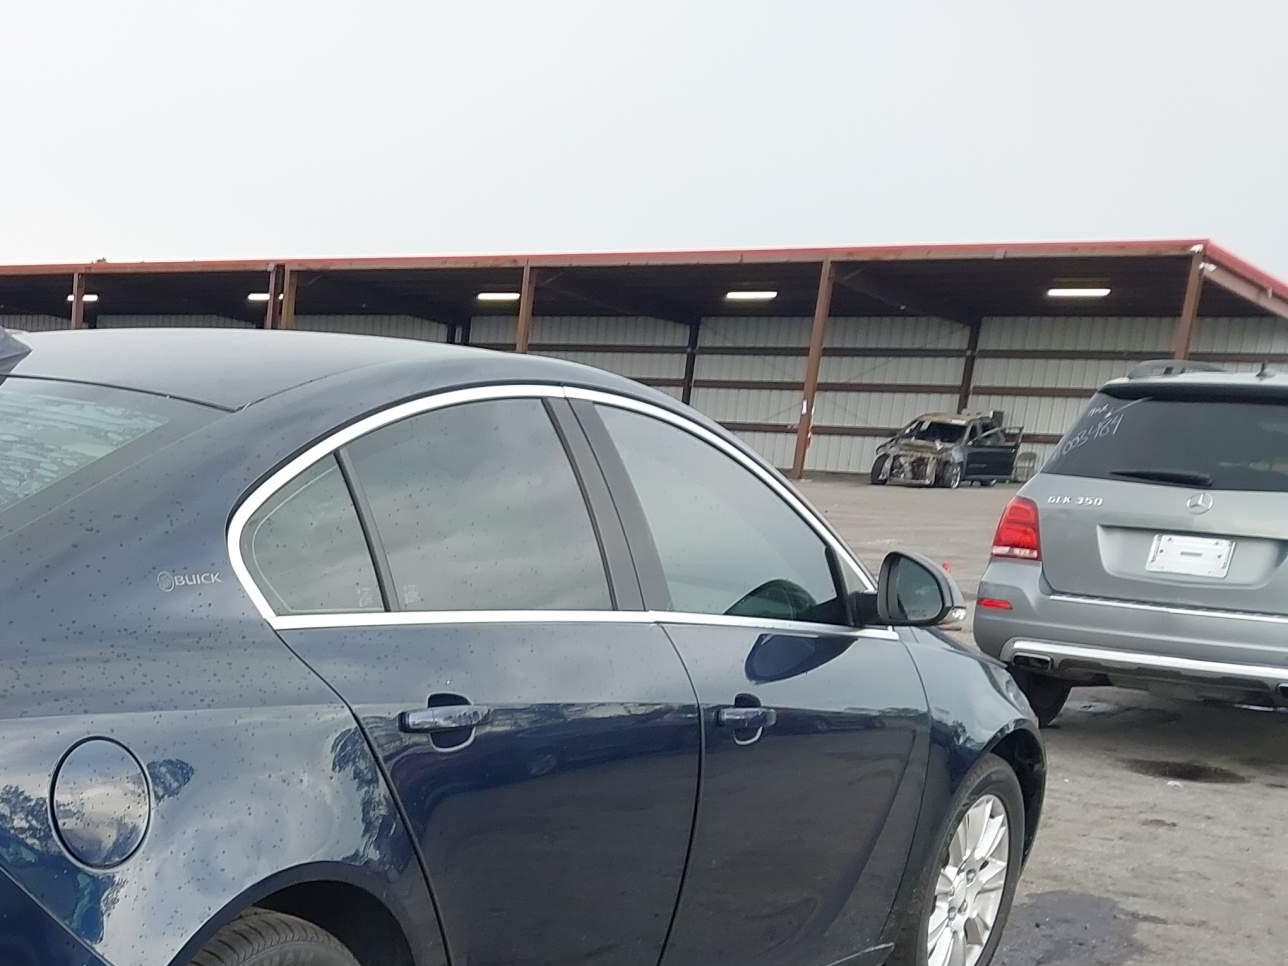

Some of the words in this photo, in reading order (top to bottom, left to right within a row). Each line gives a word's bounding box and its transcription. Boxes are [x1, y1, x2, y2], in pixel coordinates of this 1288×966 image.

[1047, 495, 1072, 505] GLK
[1076, 496, 1105, 507] 350
[174, 571, 222, 586] BUICK
